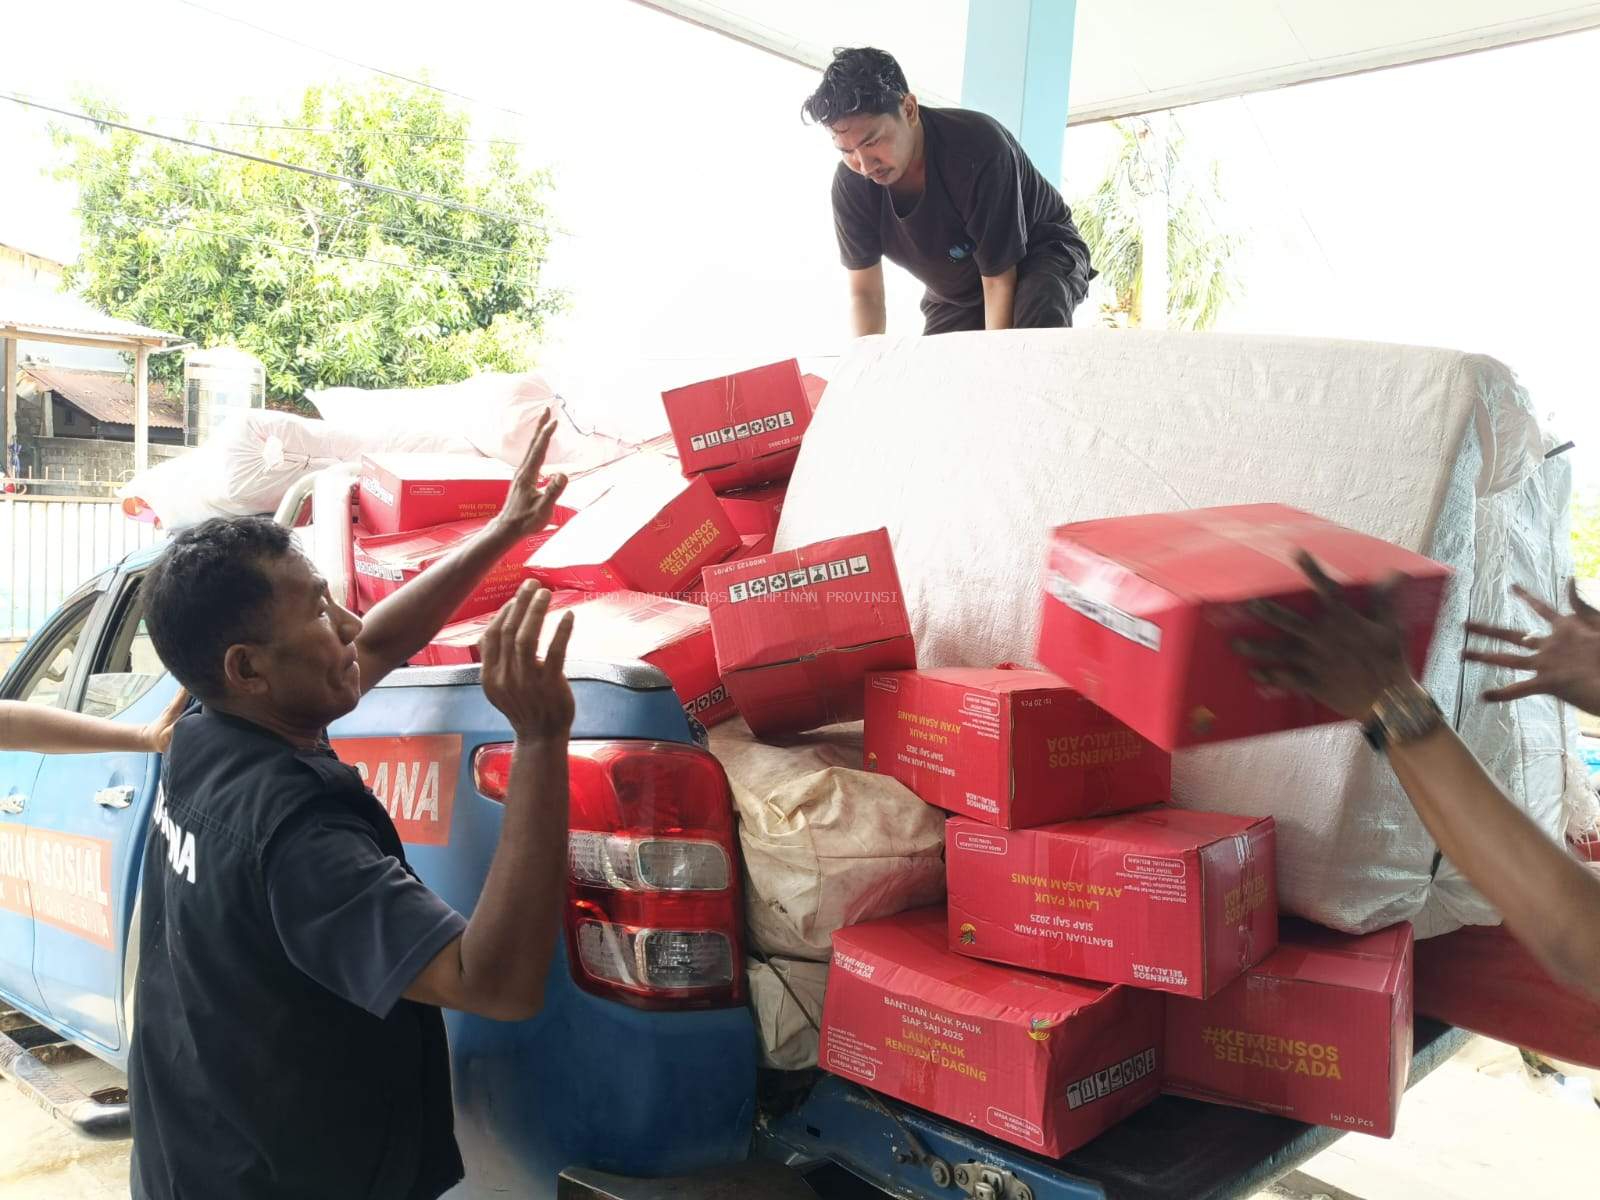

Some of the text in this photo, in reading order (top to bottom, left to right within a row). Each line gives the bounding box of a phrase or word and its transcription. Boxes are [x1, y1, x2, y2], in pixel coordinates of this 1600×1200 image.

[658, 519, 715, 574] #KEMENSOS
[896, 710, 918, 724] MANIS
[918, 715, 939, 729] ASAM
[909, 727, 948, 745] LAUK PAUK
[939, 720, 961, 734] AYAM
[911, 757, 926, 768] LAUK
[927, 762, 956, 777] BANTUAN
[40, 839, 108, 906] SOSIAL
[1010, 873, 1048, 888] MANIS
[1050, 879, 1084, 893] ASAM
[1087, 884, 1122, 898] AYAM
[1034, 892, 1100, 912] LAUK PAUK
[1029, 914, 1095, 932] SIAP SAJI 2025
[1013, 923, 1115, 949] BANTUAN LAUK PAUK
[1133, 971, 1188, 986] #KEMENSOS
[884, 996, 982, 1035] BANTUAN LAUK PAUK
[901, 1015, 964, 1041] SIAP SAJI 2025
[902, 1027, 966, 1058] LAUK PAUK
[1201, 1025, 1339, 1062] #KEMENSOS
[941, 1056, 988, 1082] DAGING
[1343, 1114, 1356, 1125] 20
[1357, 1117, 1375, 1128] Pcs
